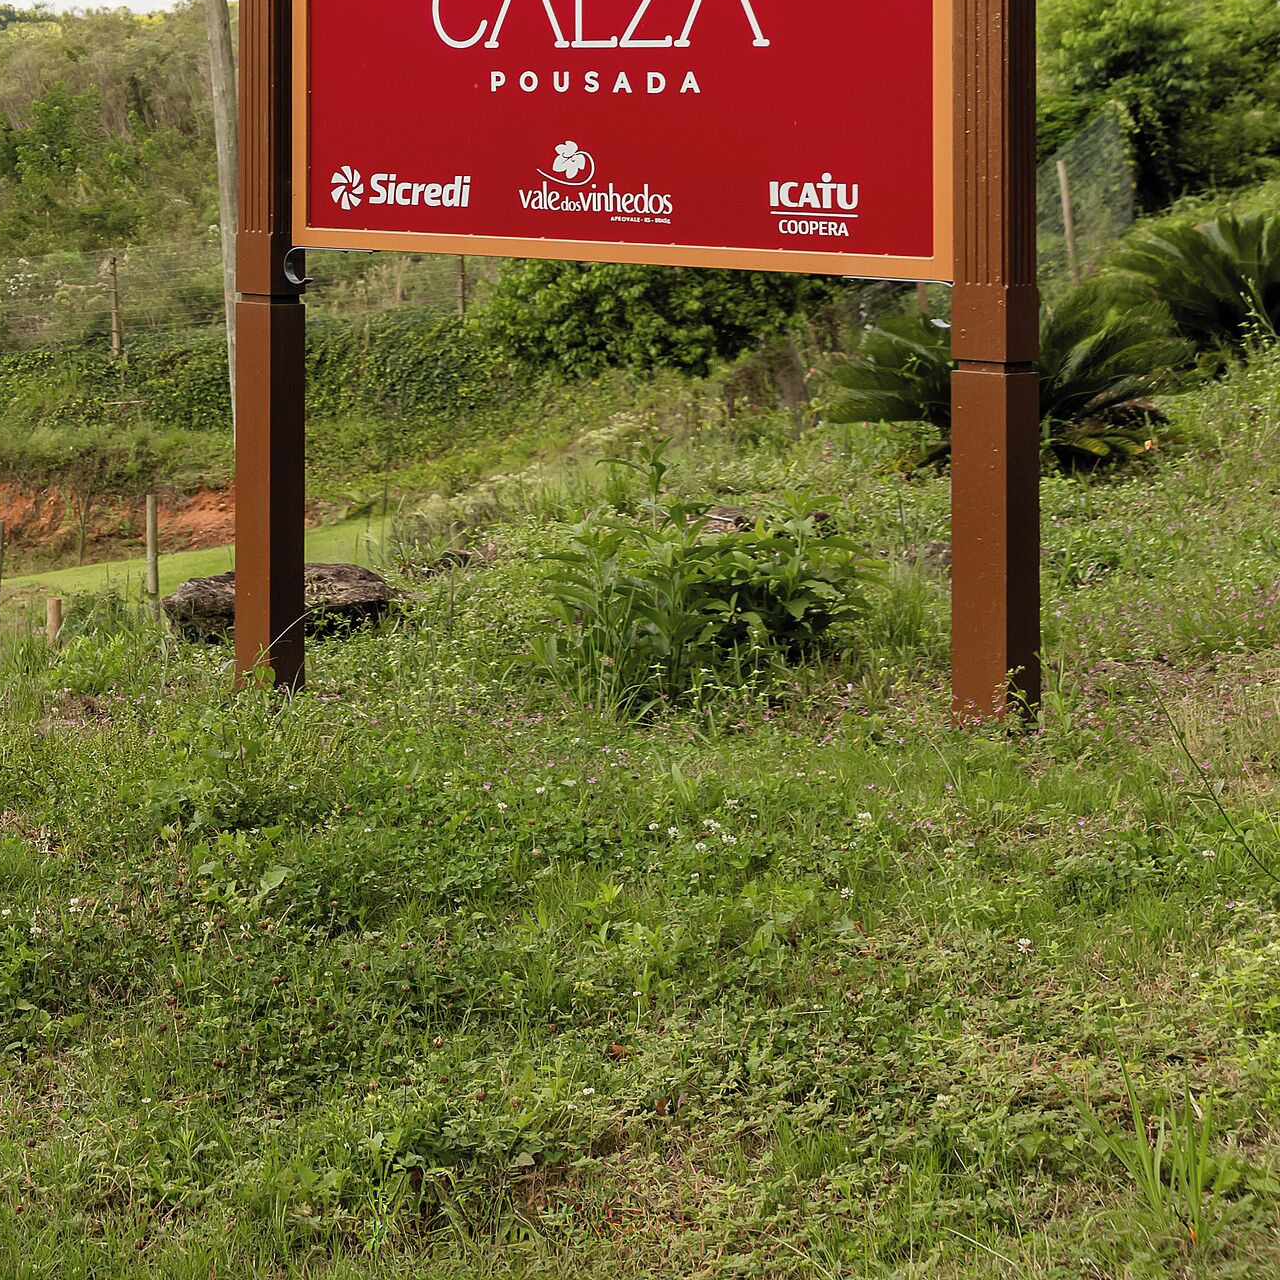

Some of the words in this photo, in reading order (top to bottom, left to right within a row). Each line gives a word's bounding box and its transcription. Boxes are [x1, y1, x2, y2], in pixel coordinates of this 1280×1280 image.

[490, 70, 701, 94] POUSADA
[368, 173, 472, 208] Sicredi
[769, 172, 859, 210] ICATU
[778, 219, 850, 237] COOPERA
